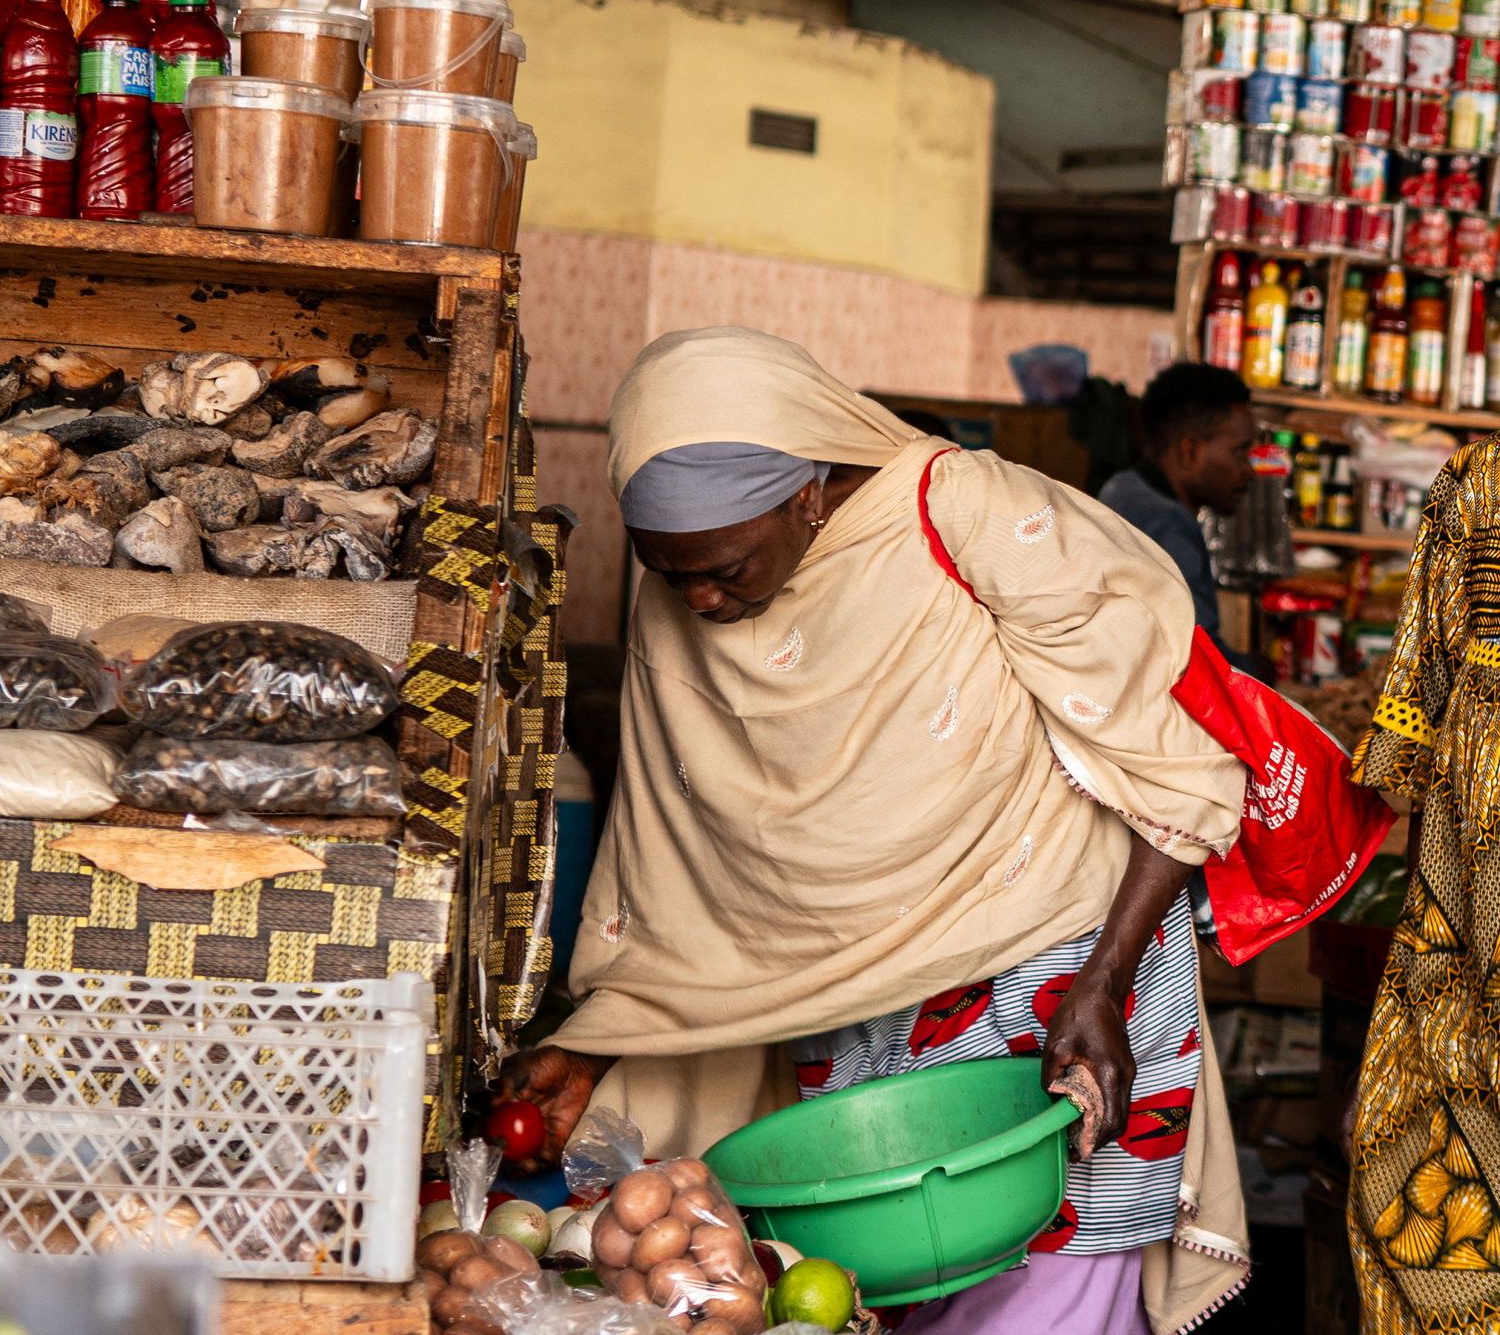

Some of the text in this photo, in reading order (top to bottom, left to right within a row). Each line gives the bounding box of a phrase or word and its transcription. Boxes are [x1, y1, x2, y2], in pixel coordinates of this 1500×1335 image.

[1269, 740, 1284, 764] BIJ
[1290, 763, 1308, 798] HART.
[1284, 794, 1300, 820] ONS
